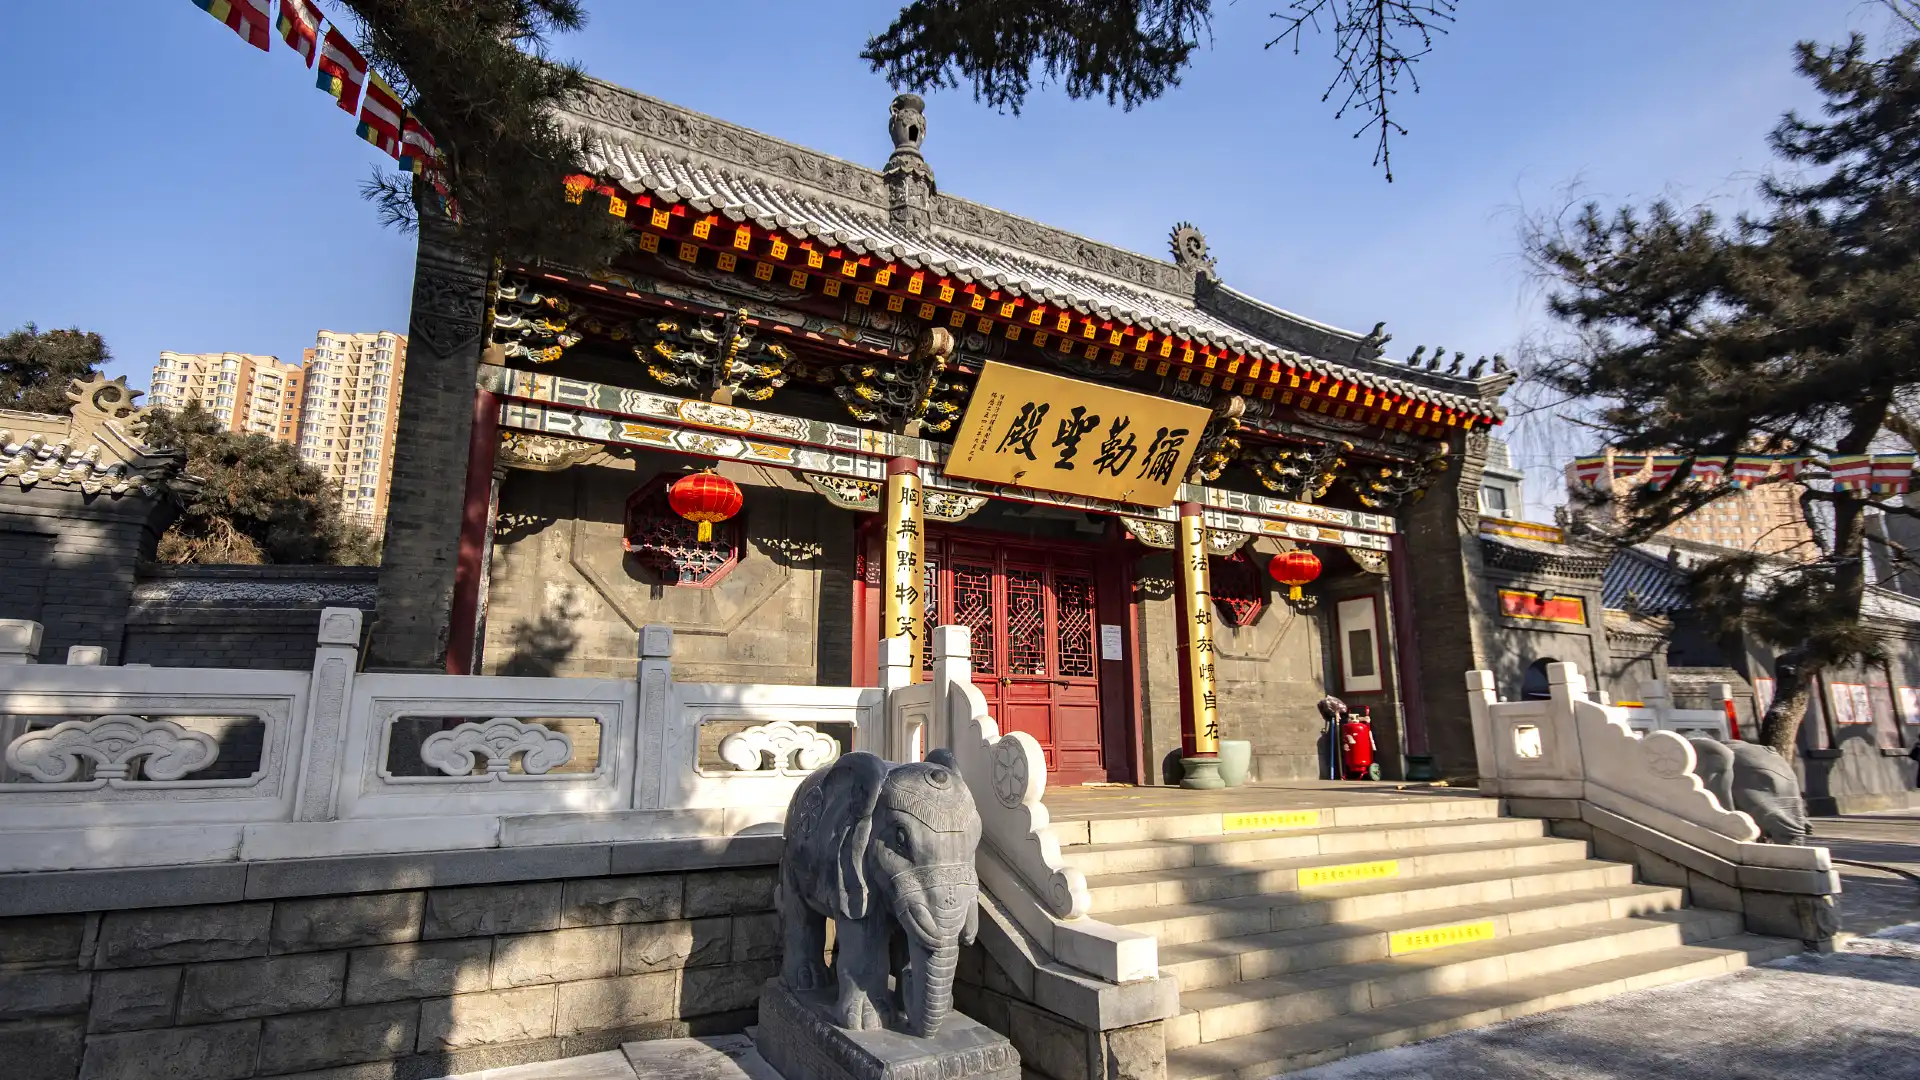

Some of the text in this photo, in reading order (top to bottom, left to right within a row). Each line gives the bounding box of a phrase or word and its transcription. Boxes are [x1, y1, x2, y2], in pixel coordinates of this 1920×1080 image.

[995, 402, 1190, 486] 彌勒聖殿
[1190, 527, 1219, 741] 了法一如放懷自在
